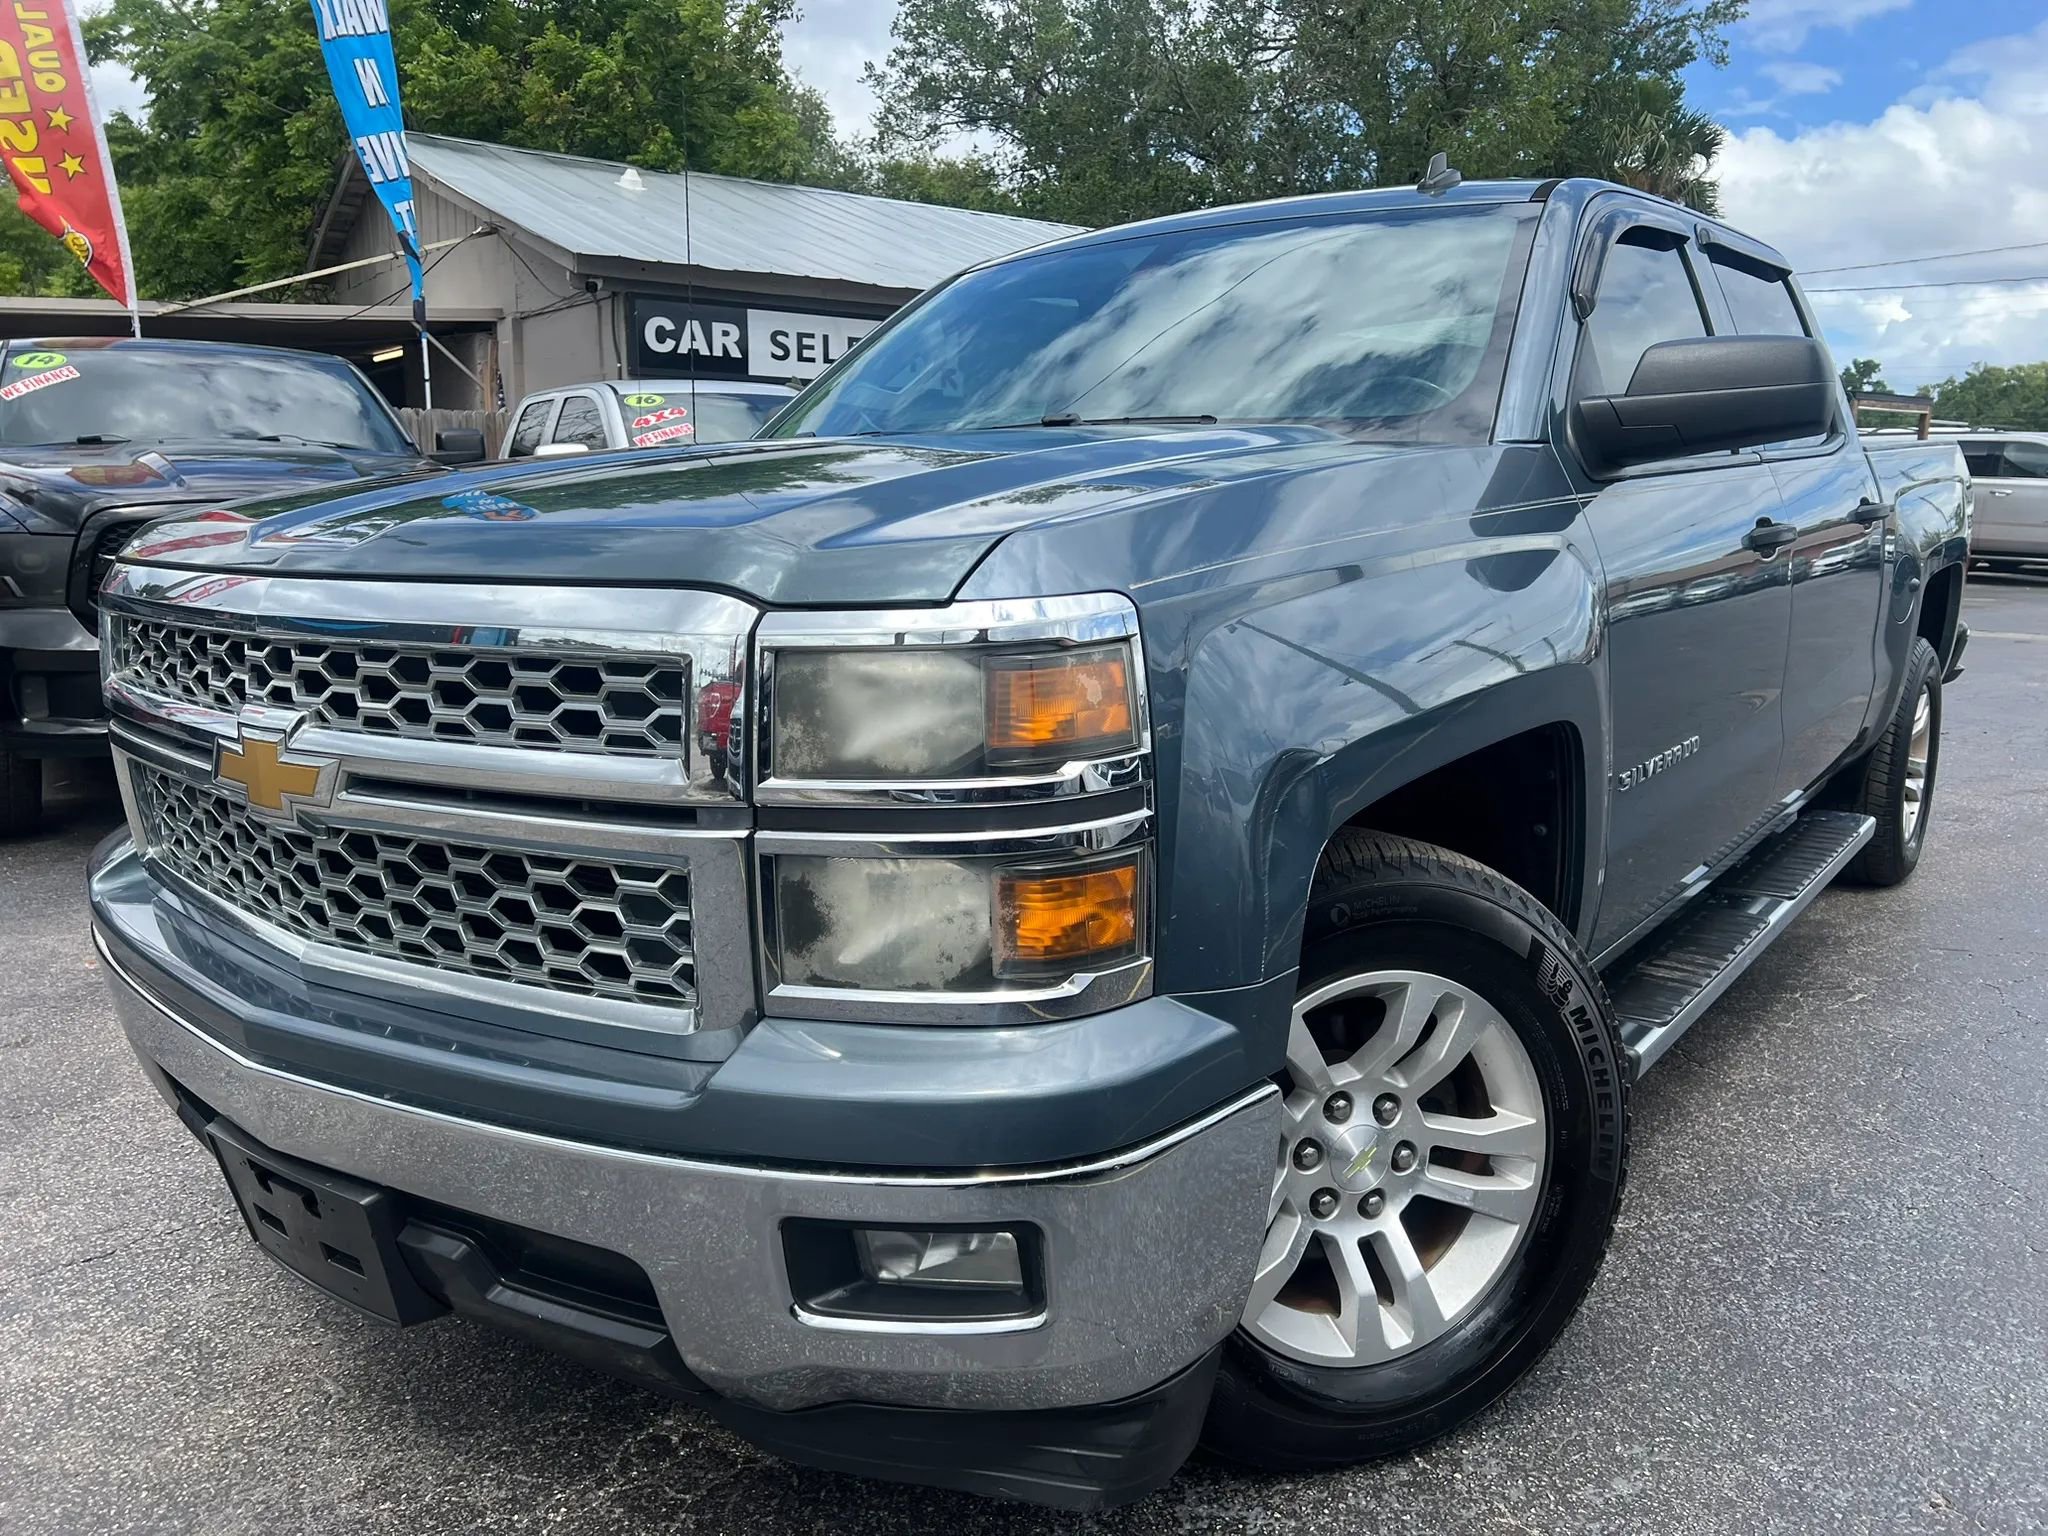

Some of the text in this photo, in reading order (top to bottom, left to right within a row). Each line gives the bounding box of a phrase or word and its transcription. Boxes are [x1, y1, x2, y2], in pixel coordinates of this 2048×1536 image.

[643, 316, 743, 359] CAR
[23, 354, 57, 365] 14
[1, 366, 78, 399] WE FINANCE
[634, 395, 657, 405] 16
[634, 423, 693, 447] WE FINANCE
[1618, 735, 1700, 792] SILVERADO
[1568, 1004, 1615, 1171] MICHELIN
